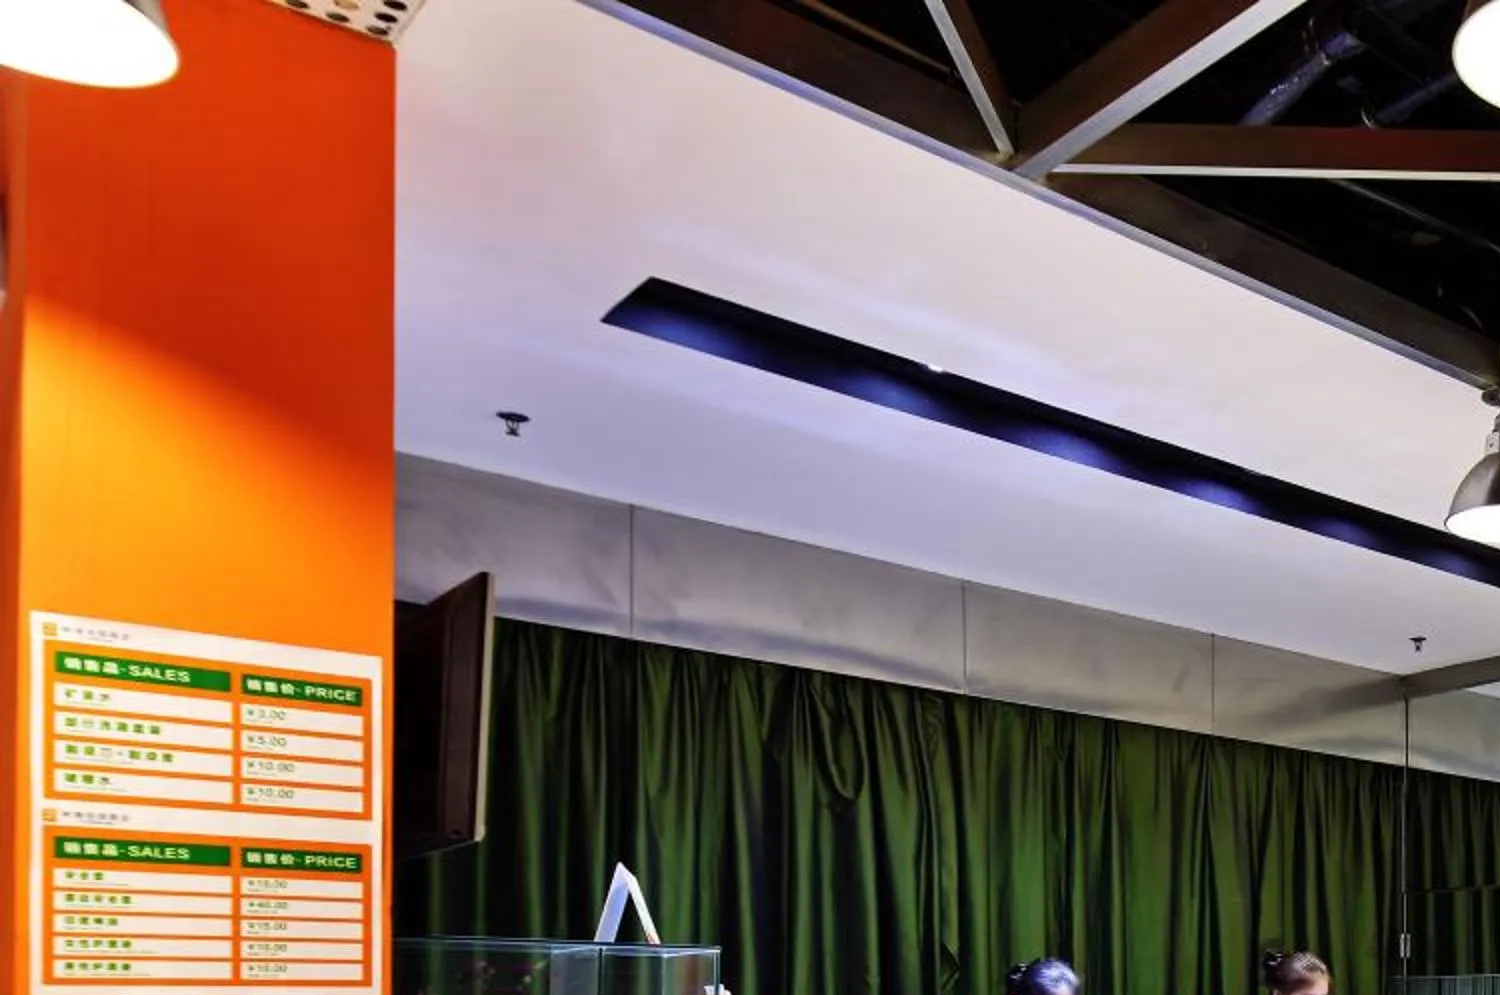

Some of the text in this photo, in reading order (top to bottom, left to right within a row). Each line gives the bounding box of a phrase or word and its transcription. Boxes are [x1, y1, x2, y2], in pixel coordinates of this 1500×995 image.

[127, 664, 192, 683] SALES
[303, 685, 358, 702] PRICE
[127, 845, 191, 860] SALES
[303, 854, 358, 869] PRICE
